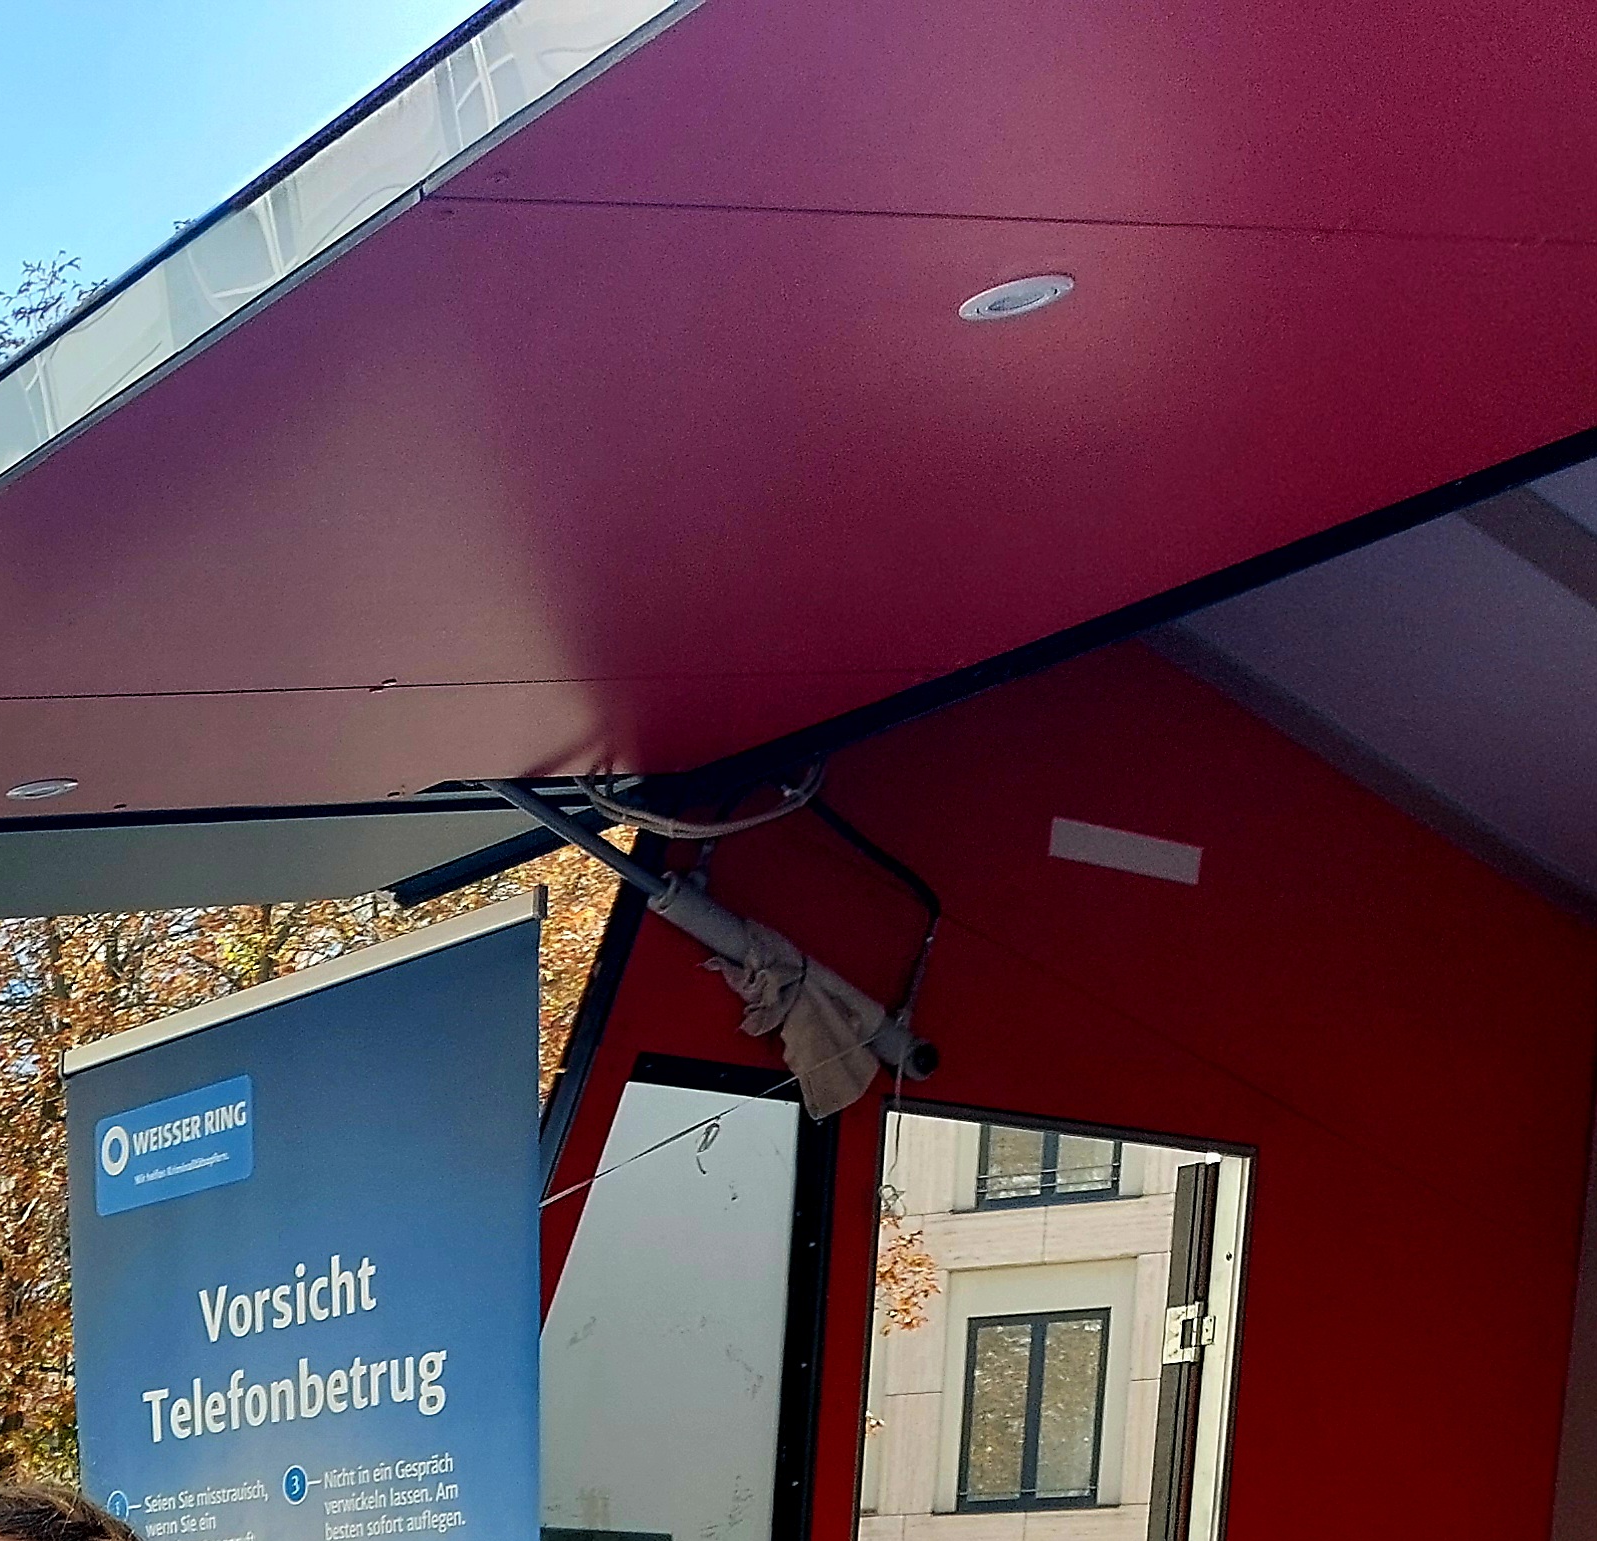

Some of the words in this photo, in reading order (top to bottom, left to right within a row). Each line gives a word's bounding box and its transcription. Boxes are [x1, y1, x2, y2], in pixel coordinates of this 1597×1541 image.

[132, 1115, 202, 1156] WEISSER
[204, 1101, 247, 1136] RING
[198, 1254, 377, 1343] Vorsicht
[142, 1350, 447, 1443] Telefonbetrug
[291, 1475, 300, 1495] 3
[324, 1467, 355, 1490] Nicht
[358, 1465, 370, 1484] in
[373, 1462, 392, 1482] ein
[395, 1452, 454, 1482] Gespräch
[144, 1492, 174, 1514] Seien
[178, 1488, 195, 1509] Sie
[196, 1479, 269, 1505] misstrauisch,
[324, 1489, 387, 1515] verwickeln
[390, 1486, 433, 1507] lassen.
[435, 1482, 459, 1502] Am
[145, 1520, 178, 1538] wenn
[180, 1513, 197, 1533] Sie
[199, 1514, 217, 1531] ein
[324, 1522, 364, 1541] besten
[367, 1514, 403, 1537] sofort
[407, 1509, 466, 1534] auflegen.
